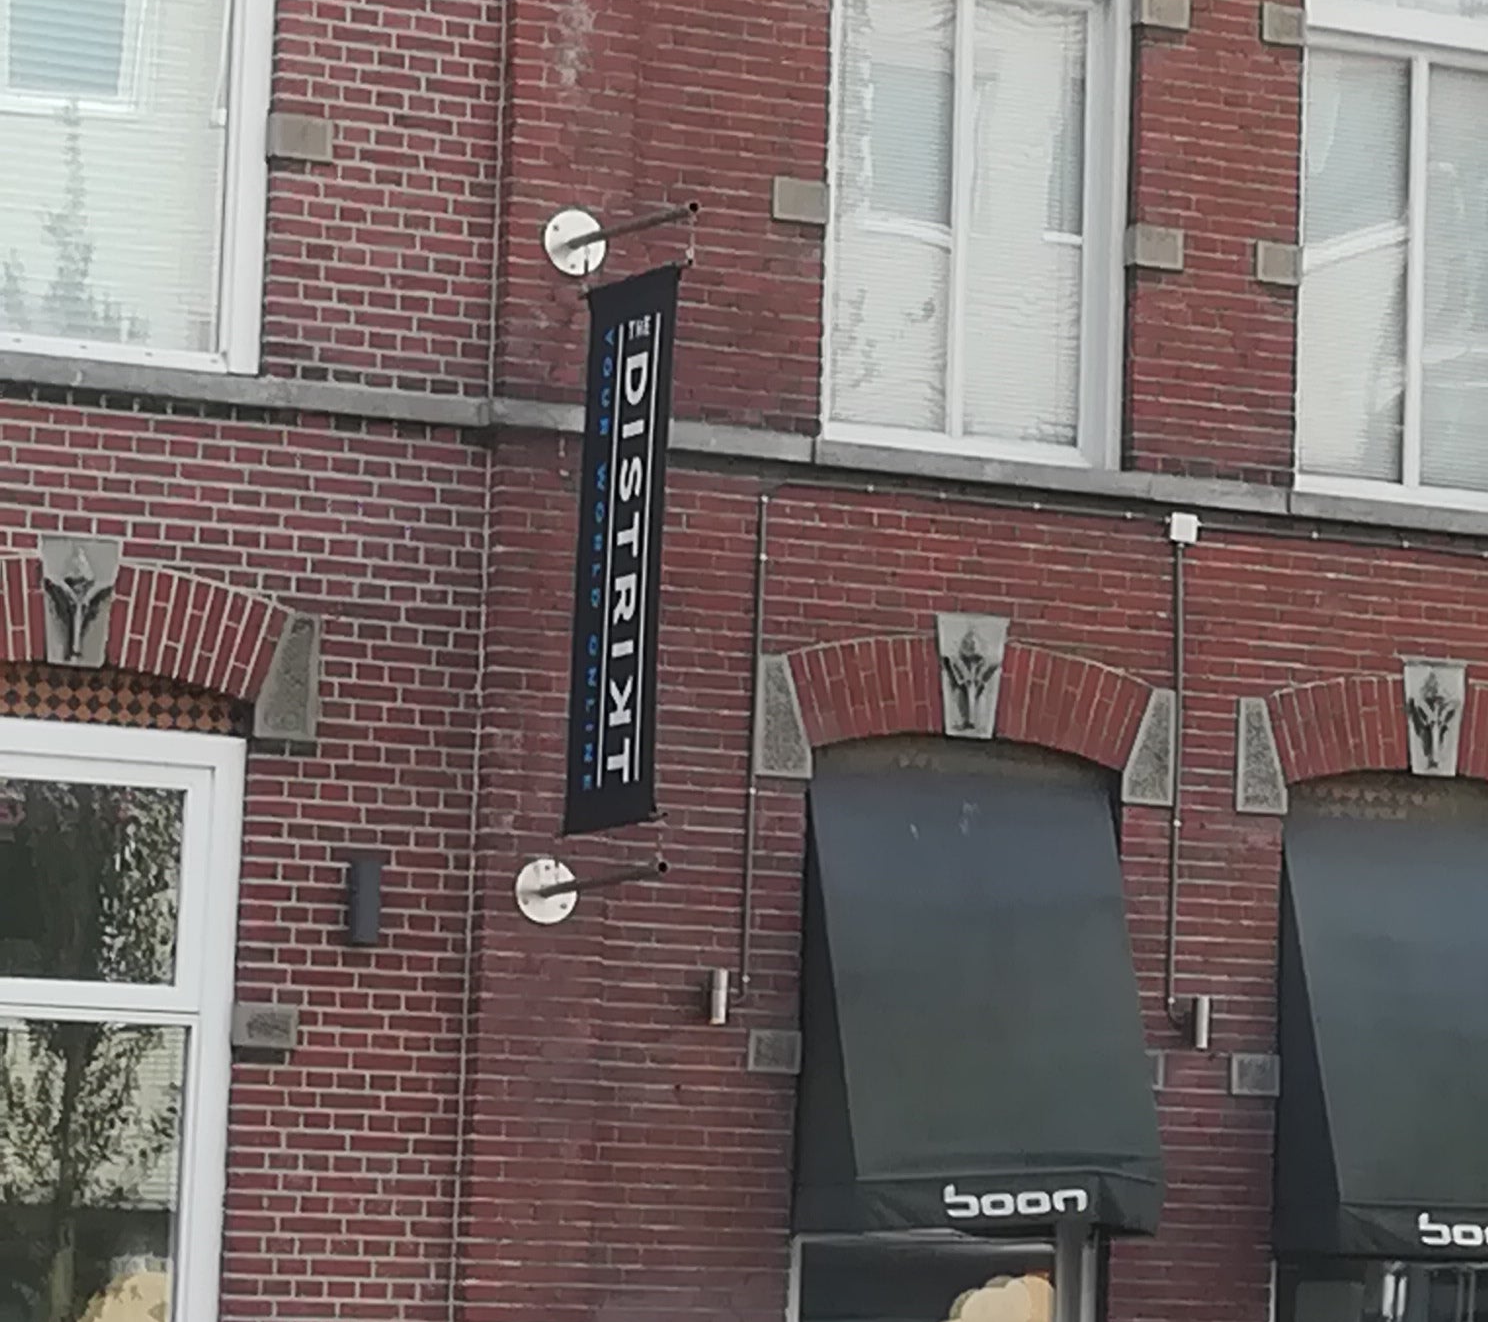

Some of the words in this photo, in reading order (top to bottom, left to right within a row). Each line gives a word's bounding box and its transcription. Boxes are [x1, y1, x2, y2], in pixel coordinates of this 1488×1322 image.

[628, 315, 651, 340] THE
[606, 351, 649, 784] DISTRIKT
[583, 634, 599, 790] ONLINE
[943, 1183, 1088, 1218] boon
